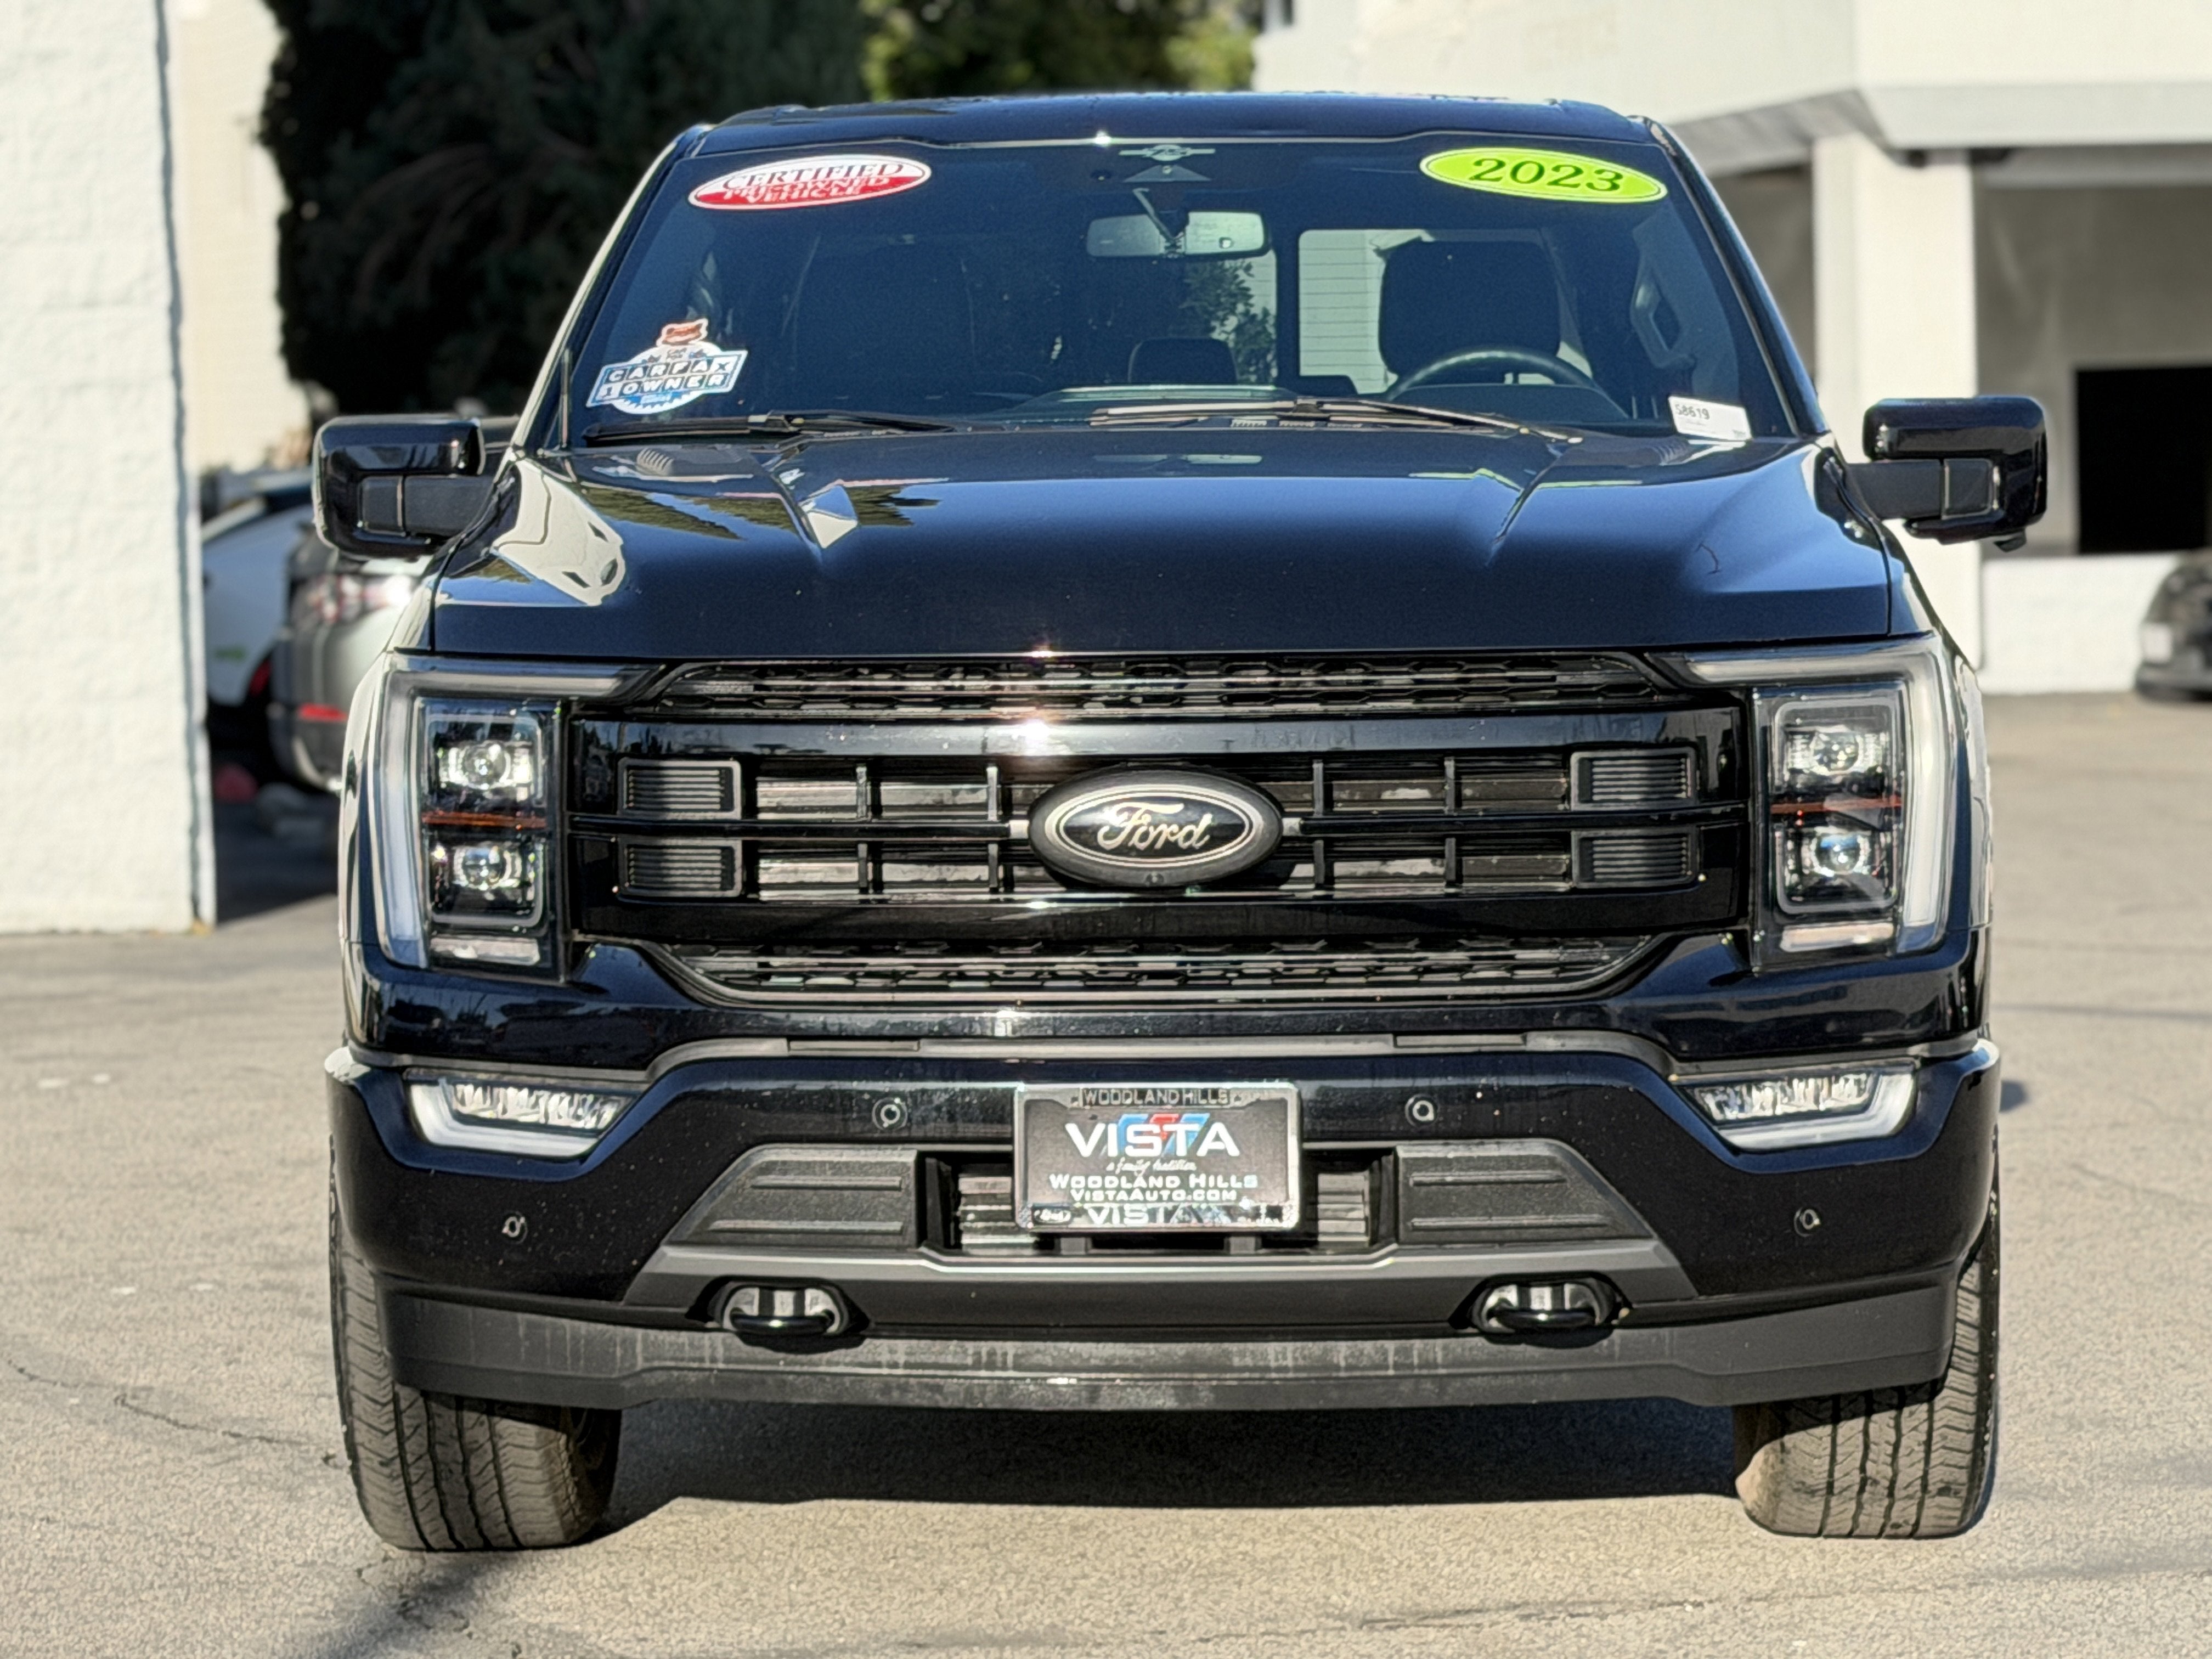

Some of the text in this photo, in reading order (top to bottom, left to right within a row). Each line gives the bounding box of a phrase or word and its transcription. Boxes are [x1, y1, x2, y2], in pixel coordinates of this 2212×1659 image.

[722, 163, 904, 190] CERTIFIED
[1469, 158, 1623, 191] 2023
[608, 360, 731, 382] CARFAX
[622, 375, 723, 395] OWNER
[1097, 802, 1214, 851] Ford
[1083, 1087, 1228, 1106] WOODLAND HILLS
[1064, 1122, 1240, 1158] VISTA
[1049, 1173, 1258, 1189] WOODLAND HILLS
